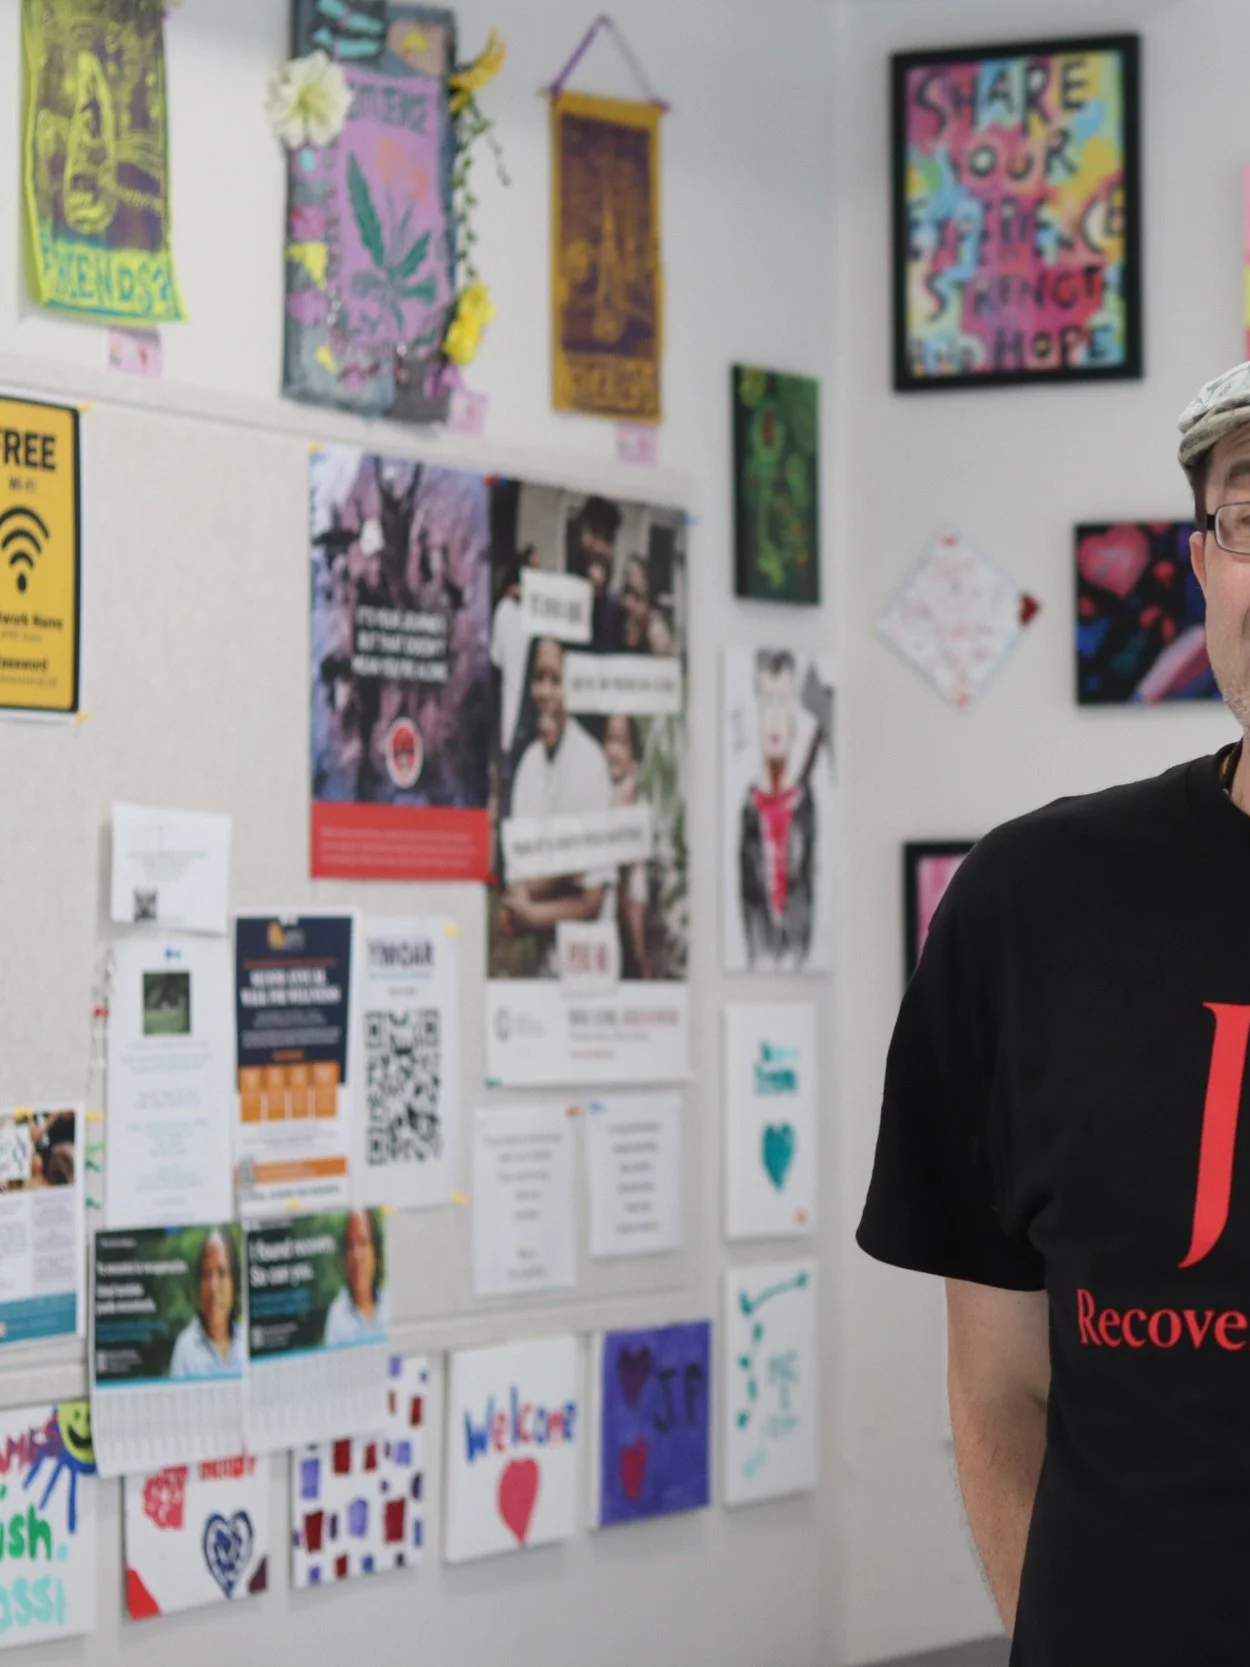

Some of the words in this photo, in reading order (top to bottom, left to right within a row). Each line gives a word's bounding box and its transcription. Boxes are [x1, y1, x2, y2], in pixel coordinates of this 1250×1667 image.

[914, 57, 1088, 137] SHARE
[994, 322, 1114, 368] HOPE
[0, 428, 57, 473] REE
[464, 1384, 577, 1464] Welcome
